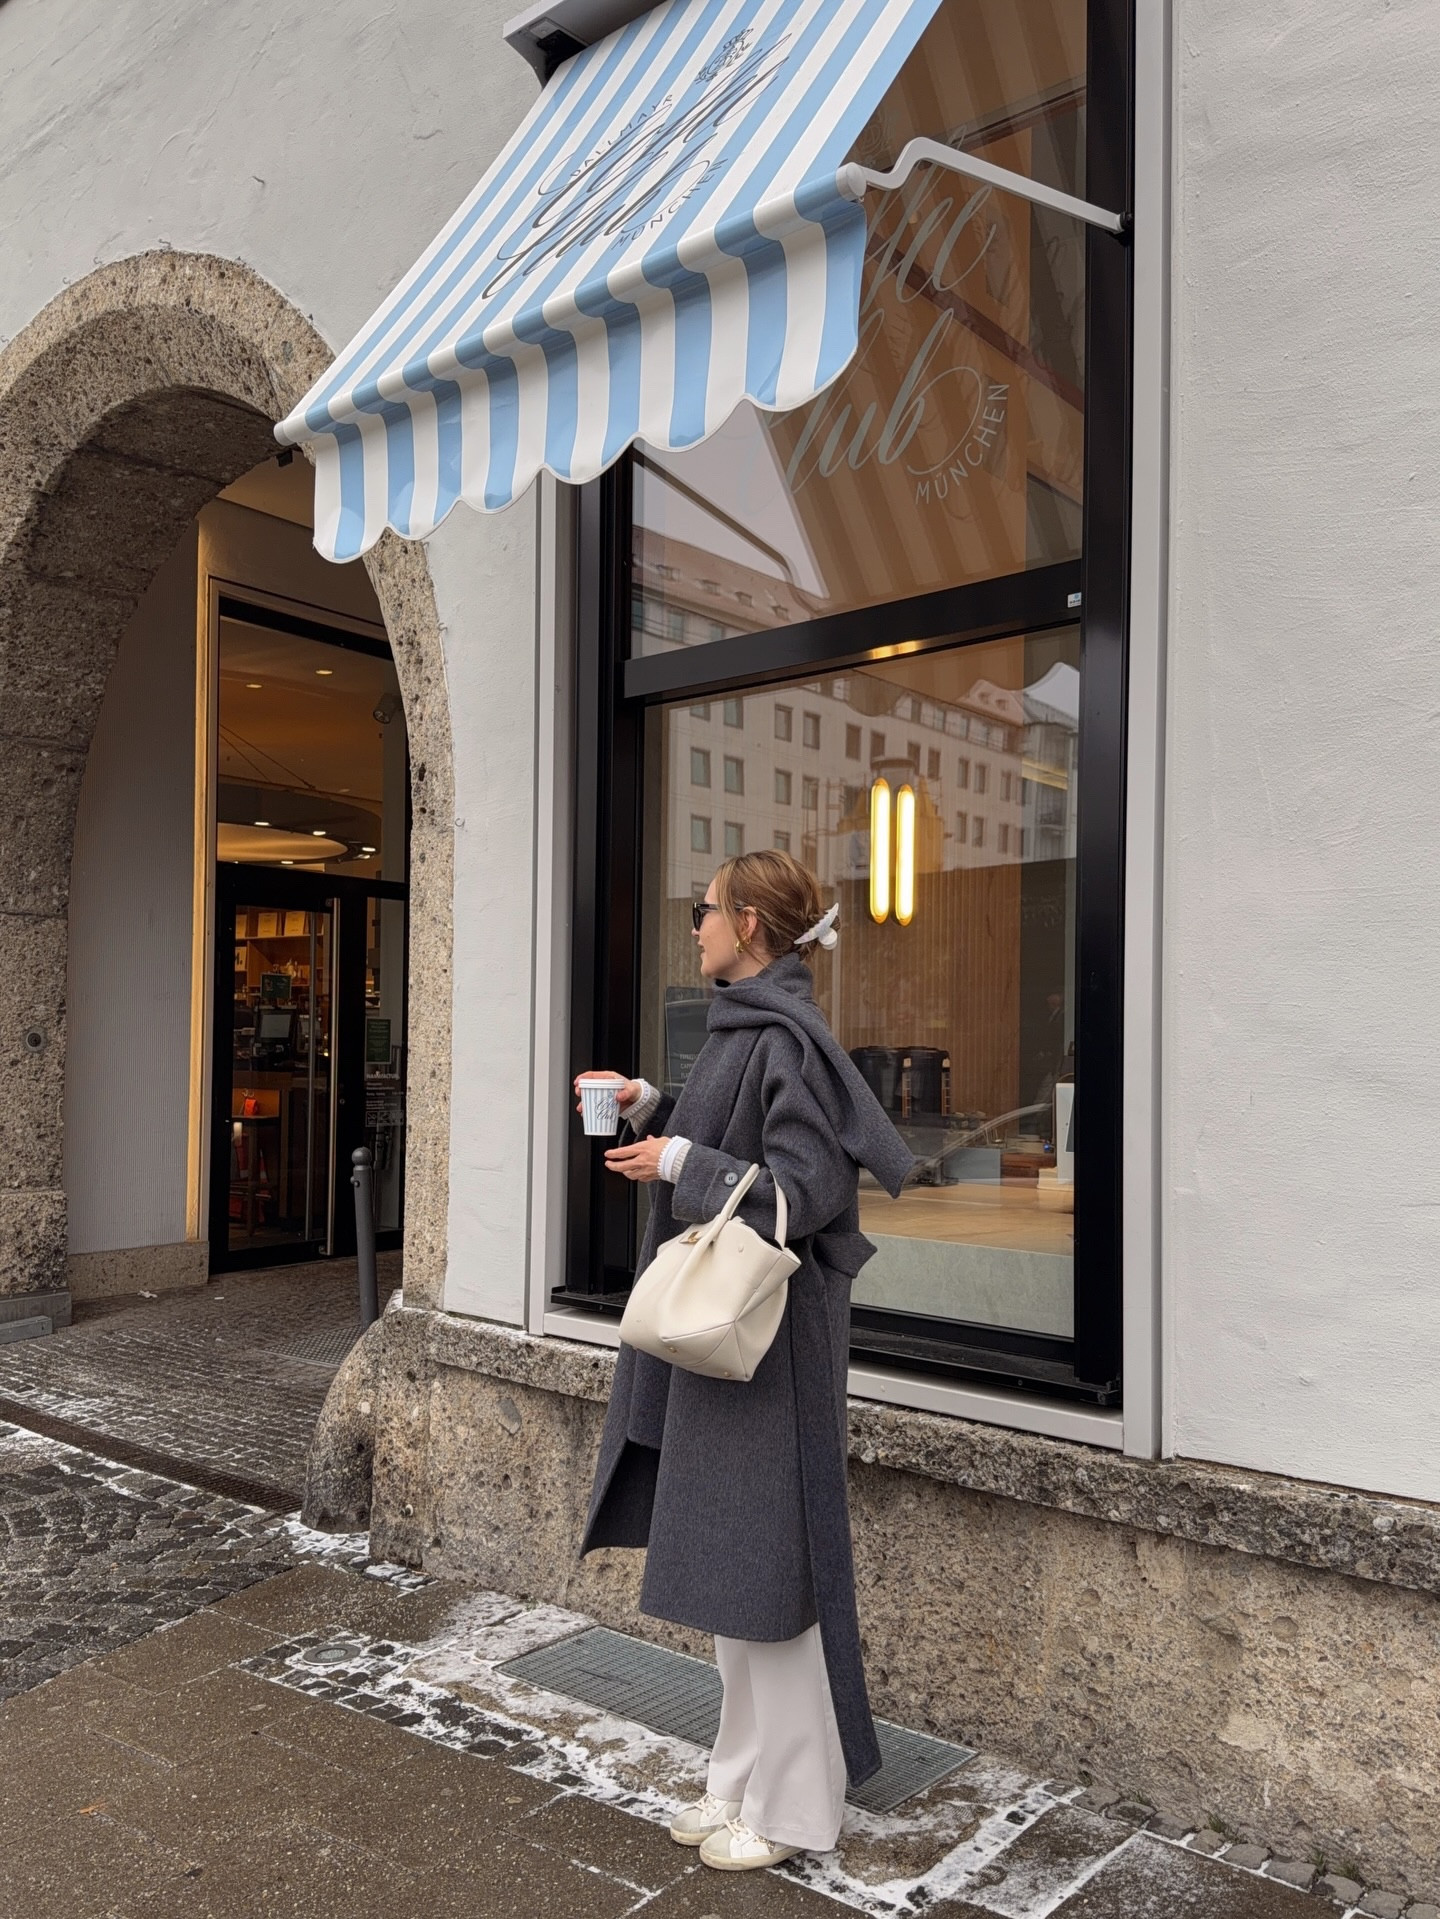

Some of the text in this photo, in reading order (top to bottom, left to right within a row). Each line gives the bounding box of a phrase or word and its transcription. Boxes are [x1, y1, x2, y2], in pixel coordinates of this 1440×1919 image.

[532, 32, 792, 229] Coffee
[570, 94, 674, 179] DALLMAYR
[482, 133, 718, 300] Club
[611, 157, 729, 251] MÜNCHEN
[785, 306, 983, 494] lub
[915, 382, 1010, 506] MÜNCHEN
